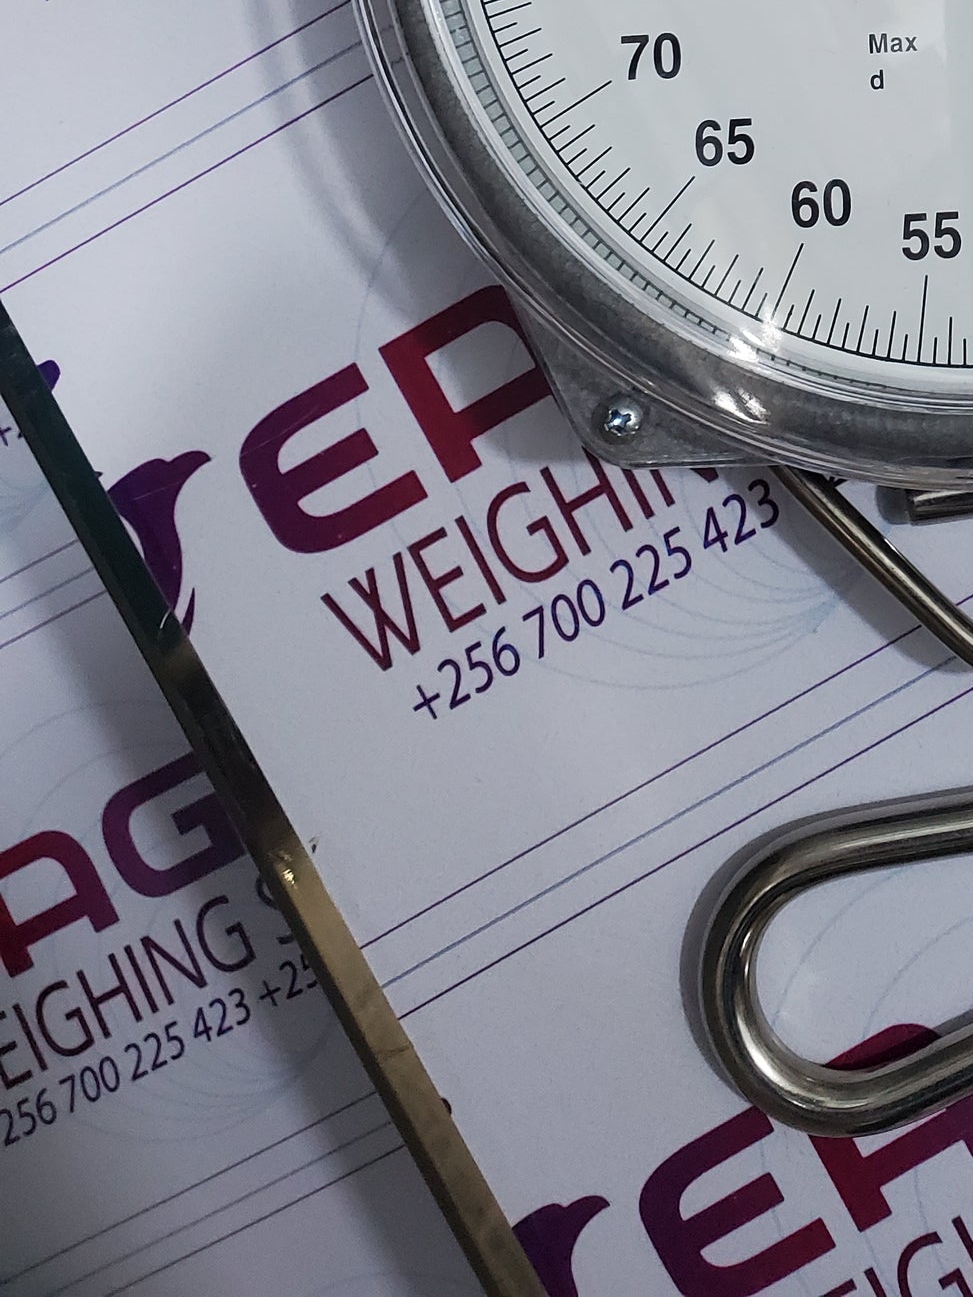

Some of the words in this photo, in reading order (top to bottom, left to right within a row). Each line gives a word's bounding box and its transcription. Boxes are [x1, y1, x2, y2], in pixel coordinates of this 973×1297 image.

[620, 33, 681, 80] 70
[868, 33, 918, 53] Max
[870, 69, 885, 90] d
[695, 118, 755, 167] 65
[791, 179, 852, 228] 60
[901, 211, 962, 261] 55
[411, 627, 520, 720] +256
[522, 579, 606, 660] 700
[610, 526, 692, 611] 225
[703, 479, 780, 553] 423
[0, 1088, 57, 1147] 256
[58, 1056, 121, 1113] 700
[124, 1021, 186, 1082] 225
[193, 988, 251, 1042] 423
